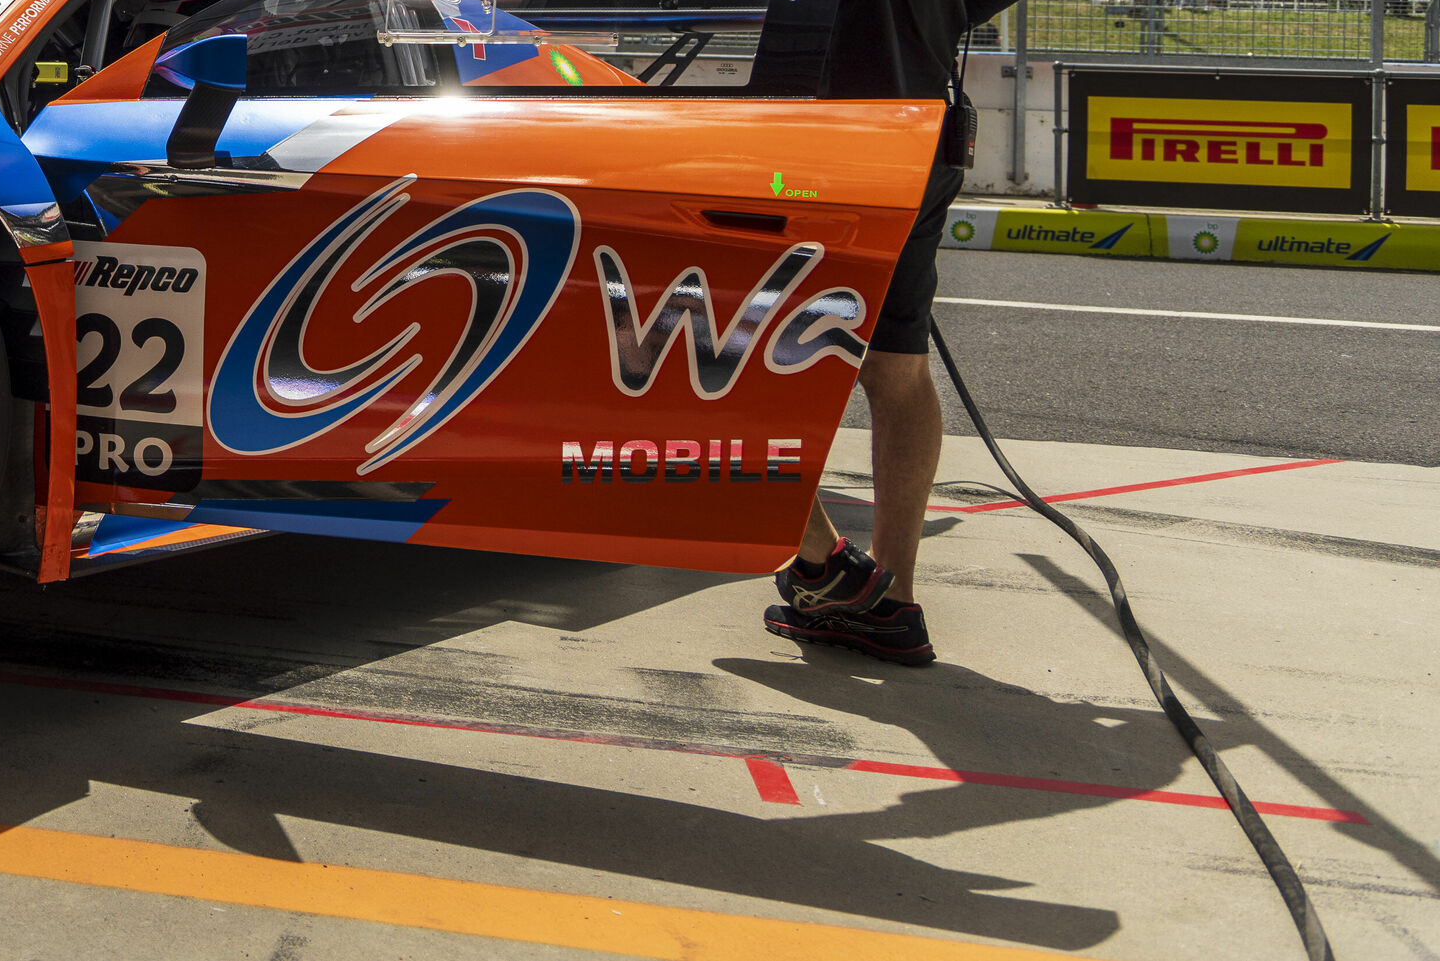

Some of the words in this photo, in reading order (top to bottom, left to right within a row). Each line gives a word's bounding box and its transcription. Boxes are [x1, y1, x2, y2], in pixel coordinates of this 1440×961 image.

[1109, 117, 1328, 167] PIRELLI
[786, 189, 818, 198] OPEN
[1006, 225, 1096, 244] ultimate
[1257, 235, 1351, 255] ultimate
[85, 255, 199, 297] Repco
[76, 312, 186, 414] 22
[75, 429, 173, 477] PRO
[561, 438, 802, 485] MOBILE
